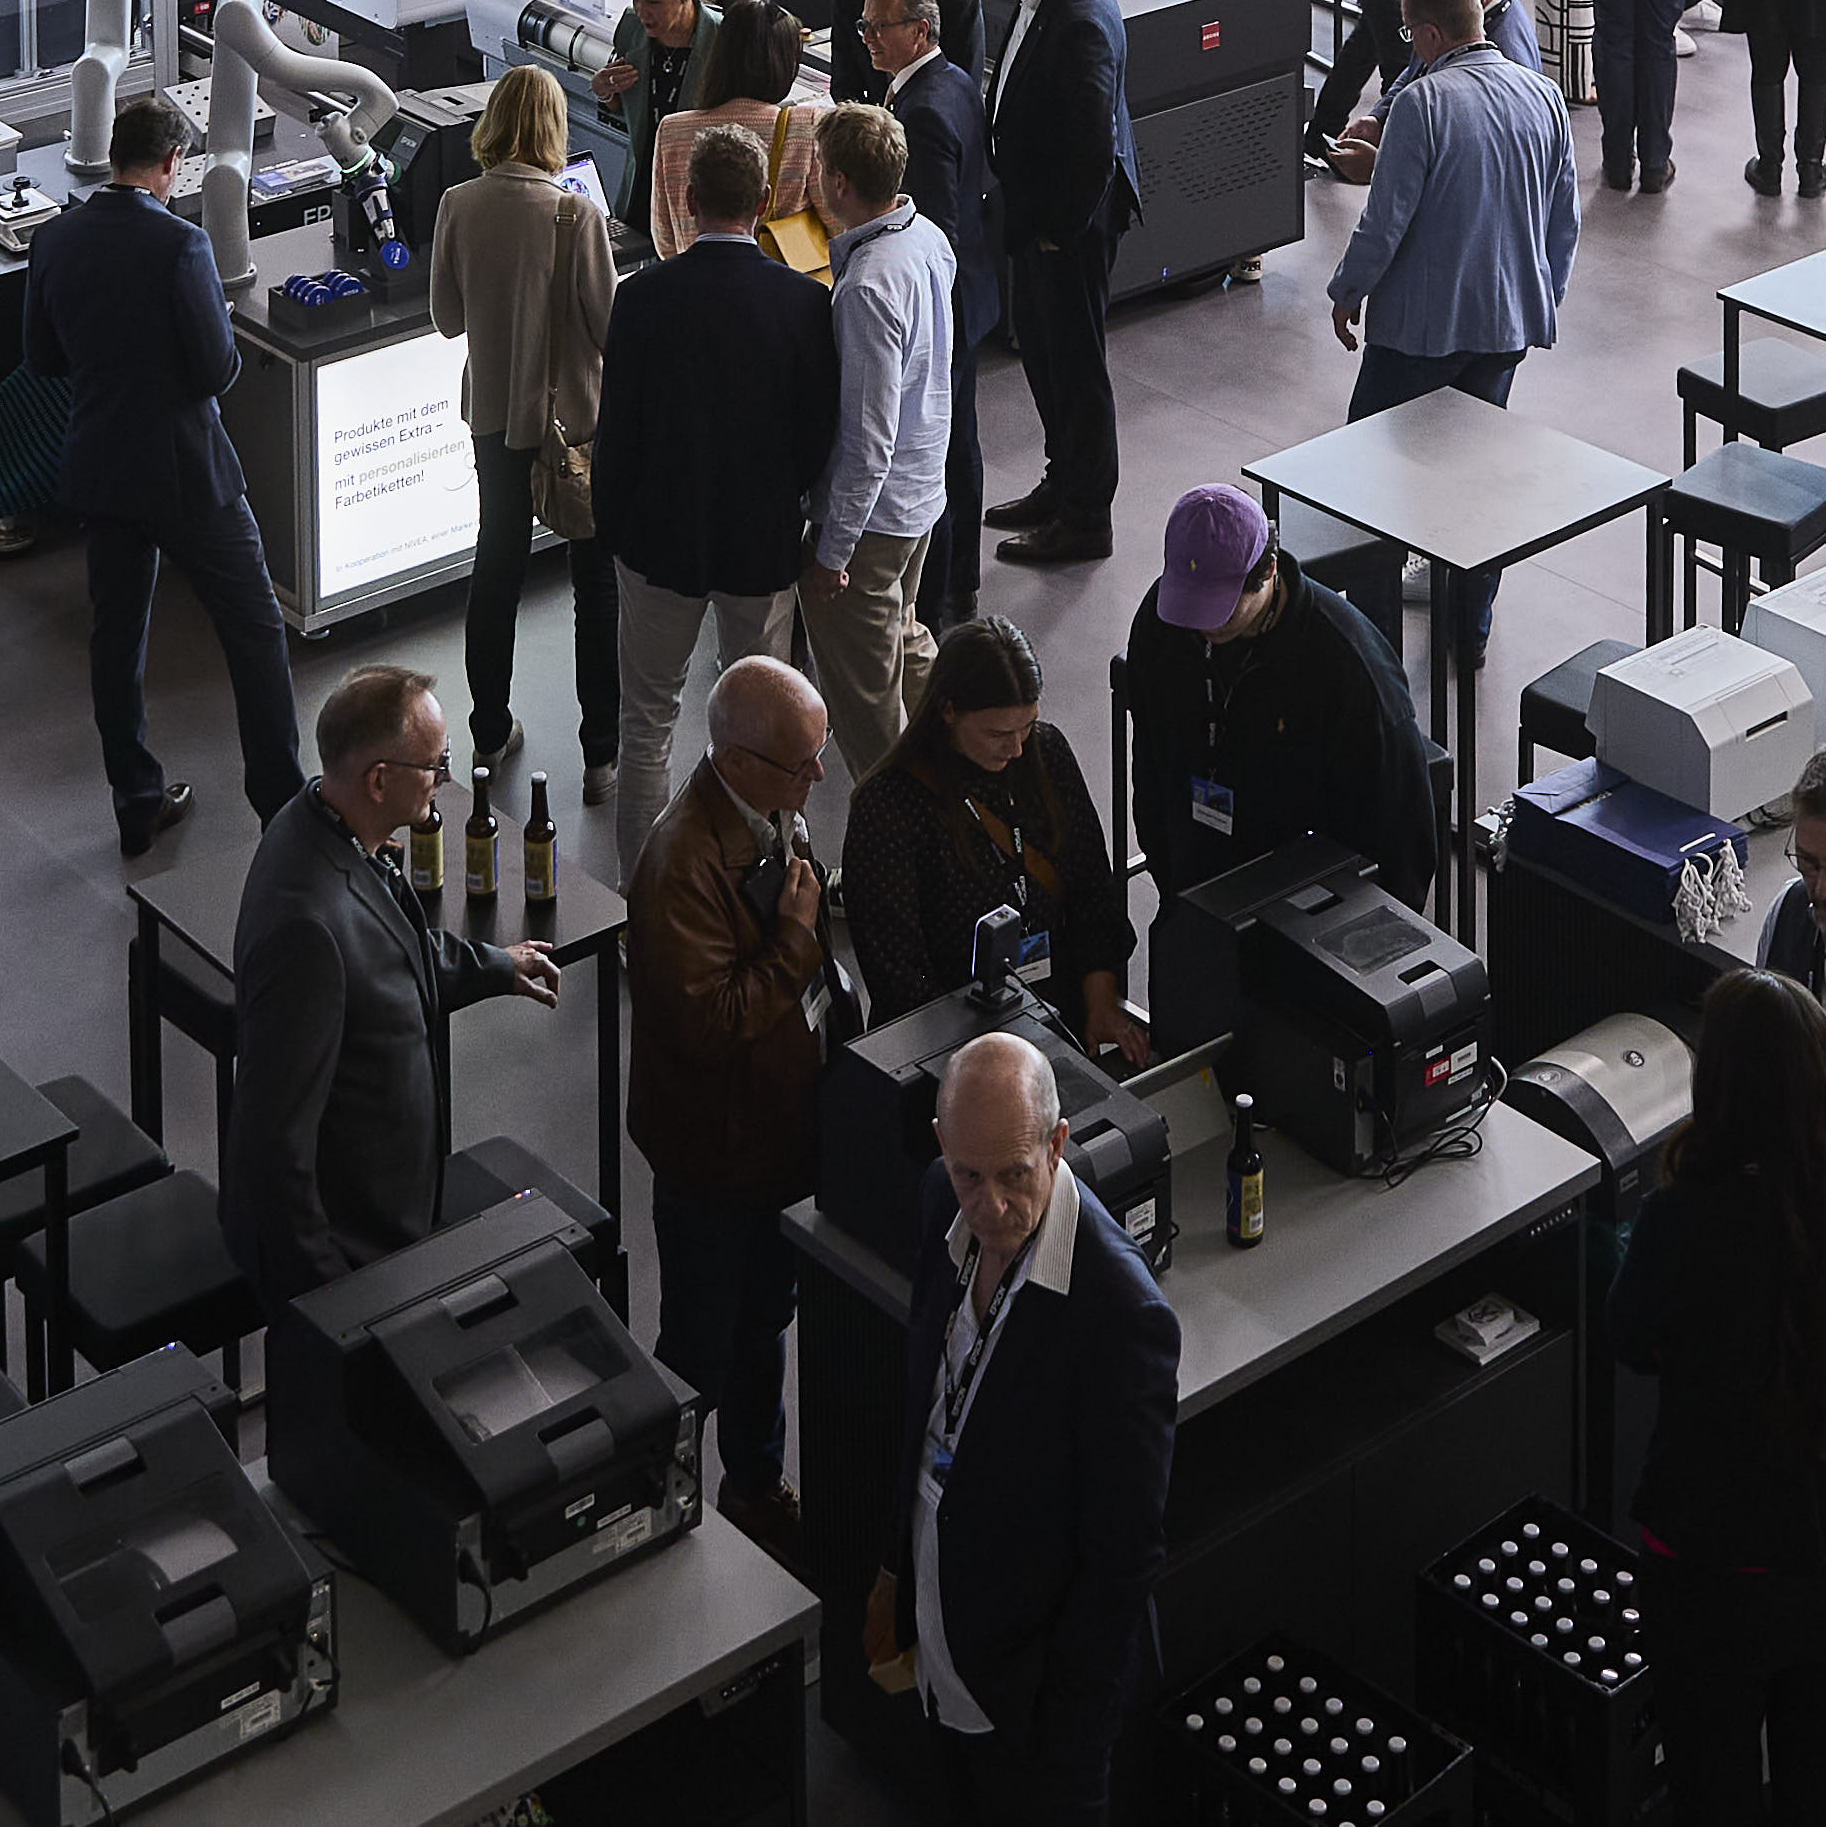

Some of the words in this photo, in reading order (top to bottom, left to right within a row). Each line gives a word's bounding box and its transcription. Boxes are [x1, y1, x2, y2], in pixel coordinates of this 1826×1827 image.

[334, 417, 393, 444] Produkte
[396, 408, 417, 424] mit
[420, 399, 449, 417] dem
[334, 435, 395, 466] gewissen
[399, 424, 432, 442] Extra
[334, 474, 355, 491] mit
[359, 439, 465, 486] personalisierten
[335, 469, 425, 510] Farbetiketten!
[988, 1284, 1006, 1316] EPSON
[969, 1336, 984, 1367] EPSON
[951, 1386, 967, 1417] EPSON
